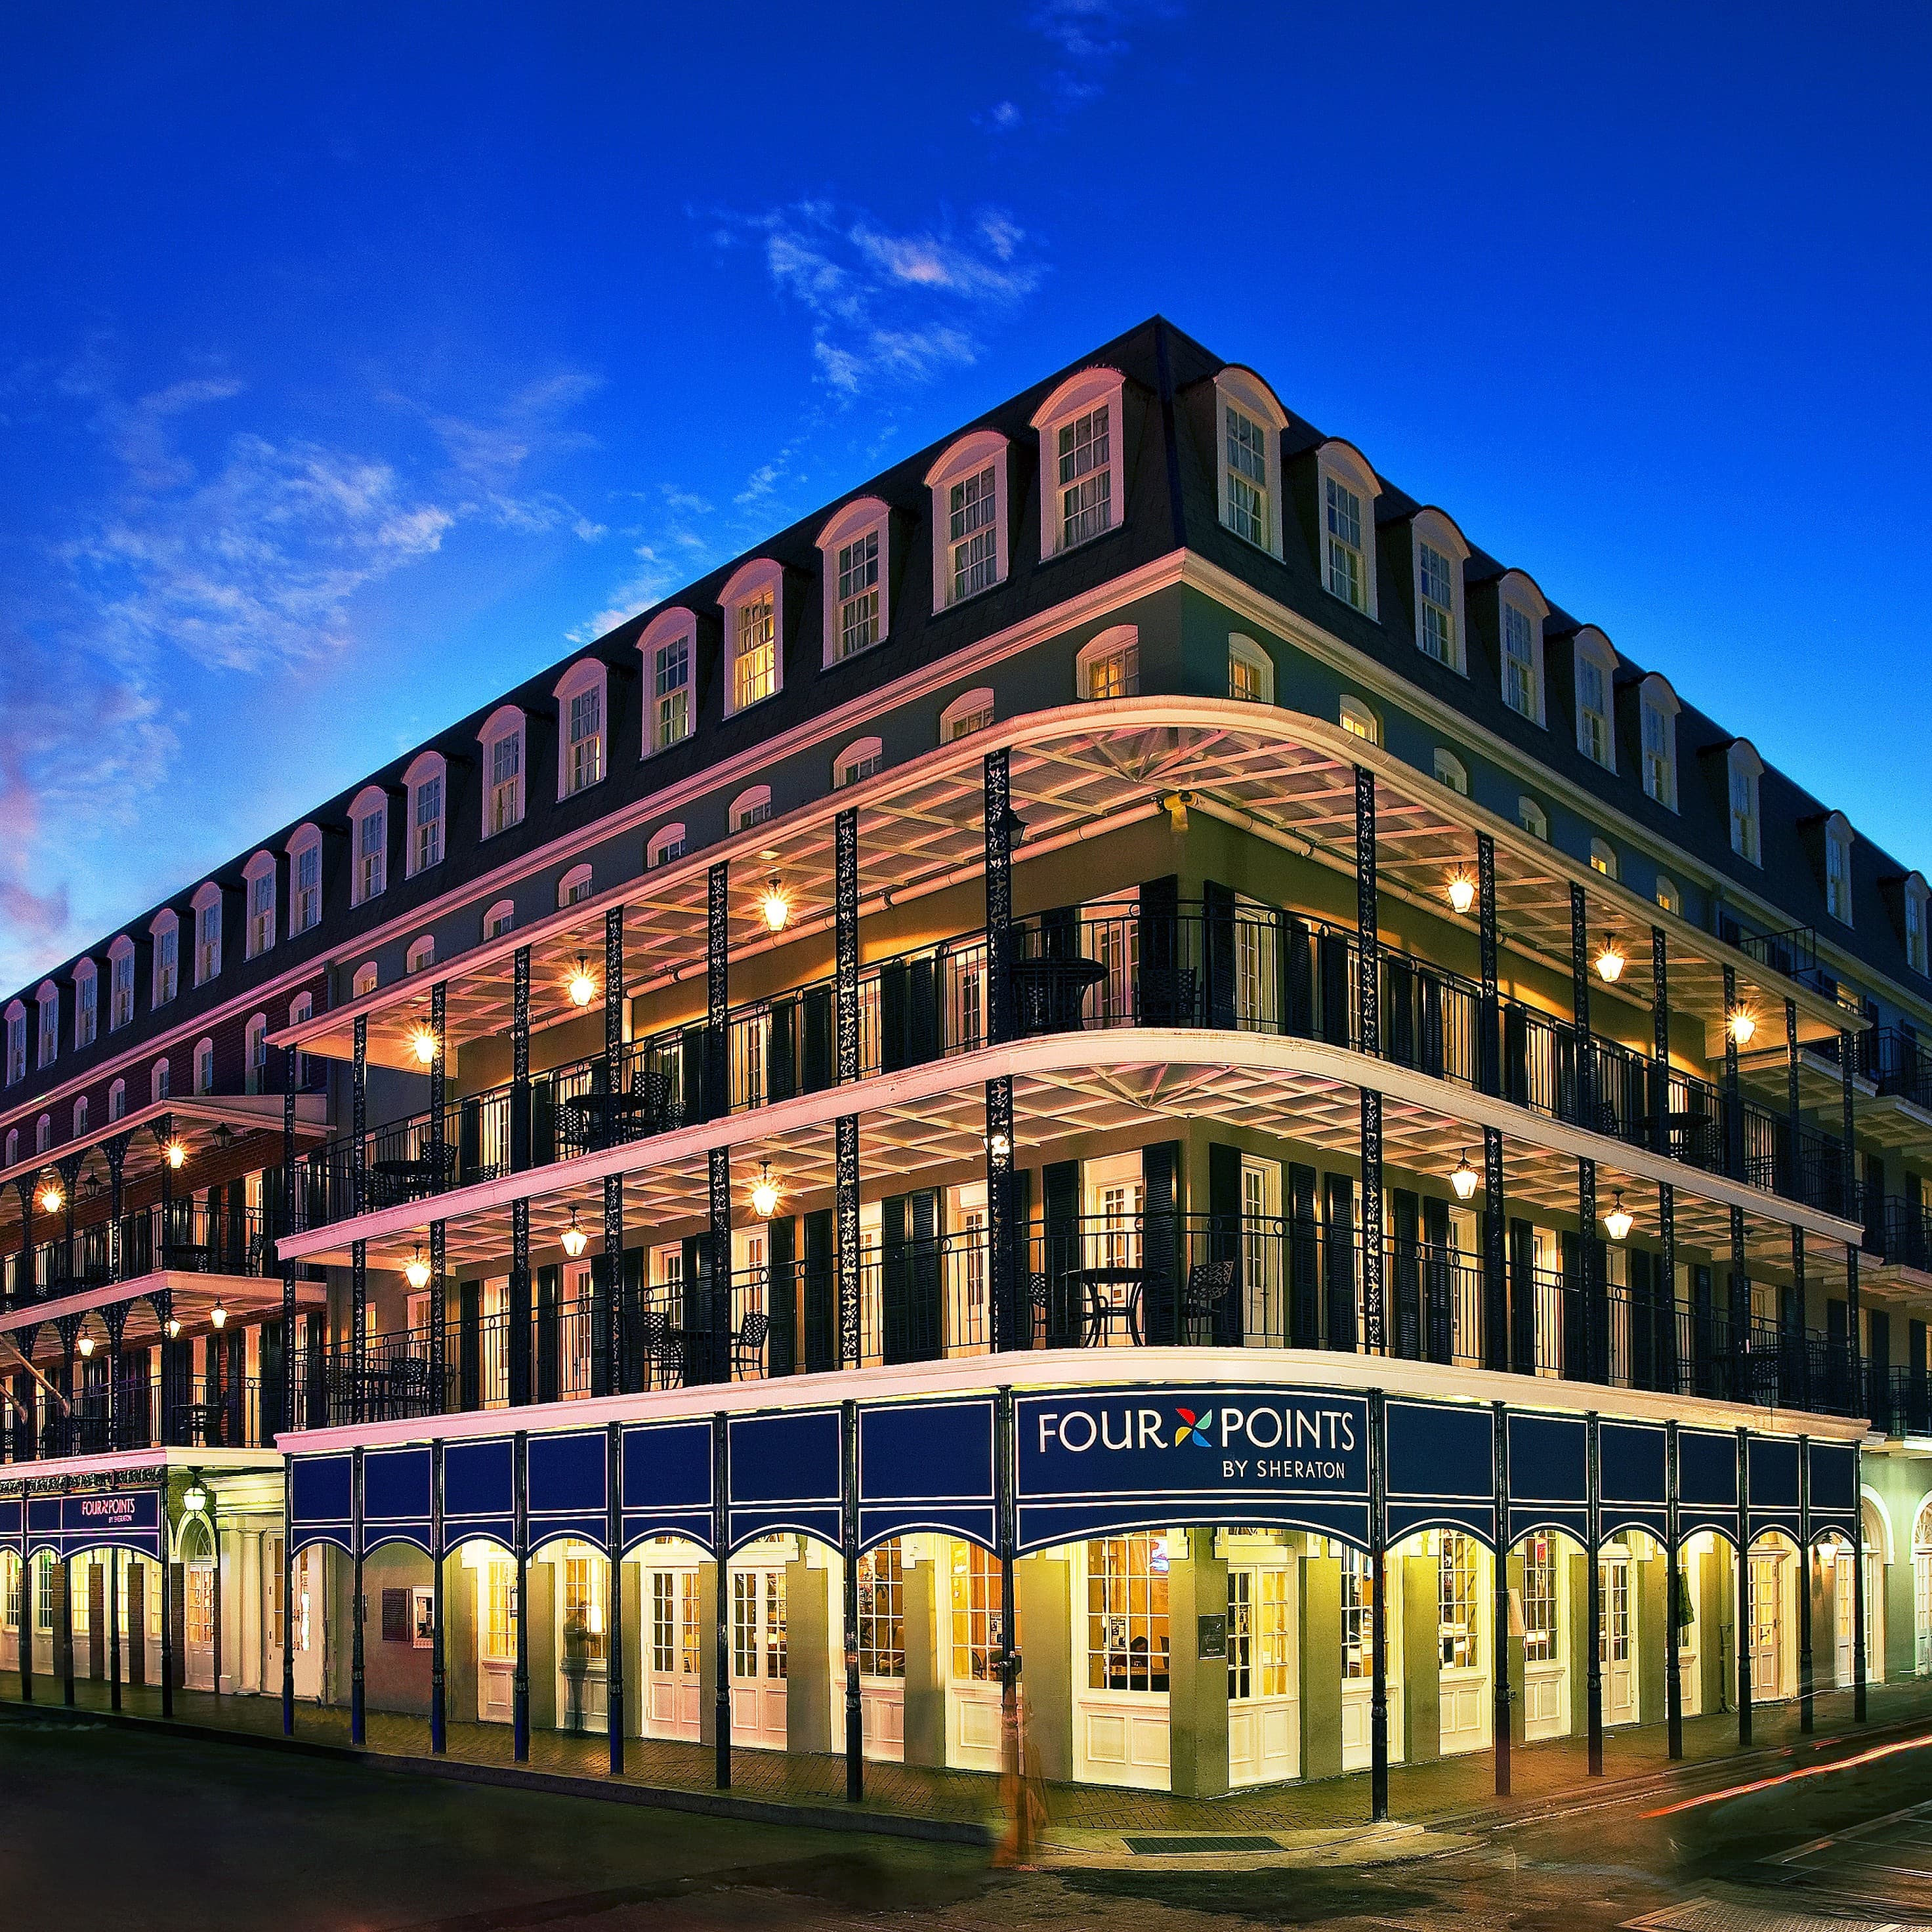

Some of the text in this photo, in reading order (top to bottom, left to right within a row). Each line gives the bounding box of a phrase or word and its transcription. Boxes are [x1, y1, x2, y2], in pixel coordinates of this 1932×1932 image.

[1039, 1407, 1354, 1453] FOUR POINTS
[1223, 1460, 1345, 1479] BY SHERATON
[81, 1498, 135, 1516] FOUR POINTS
